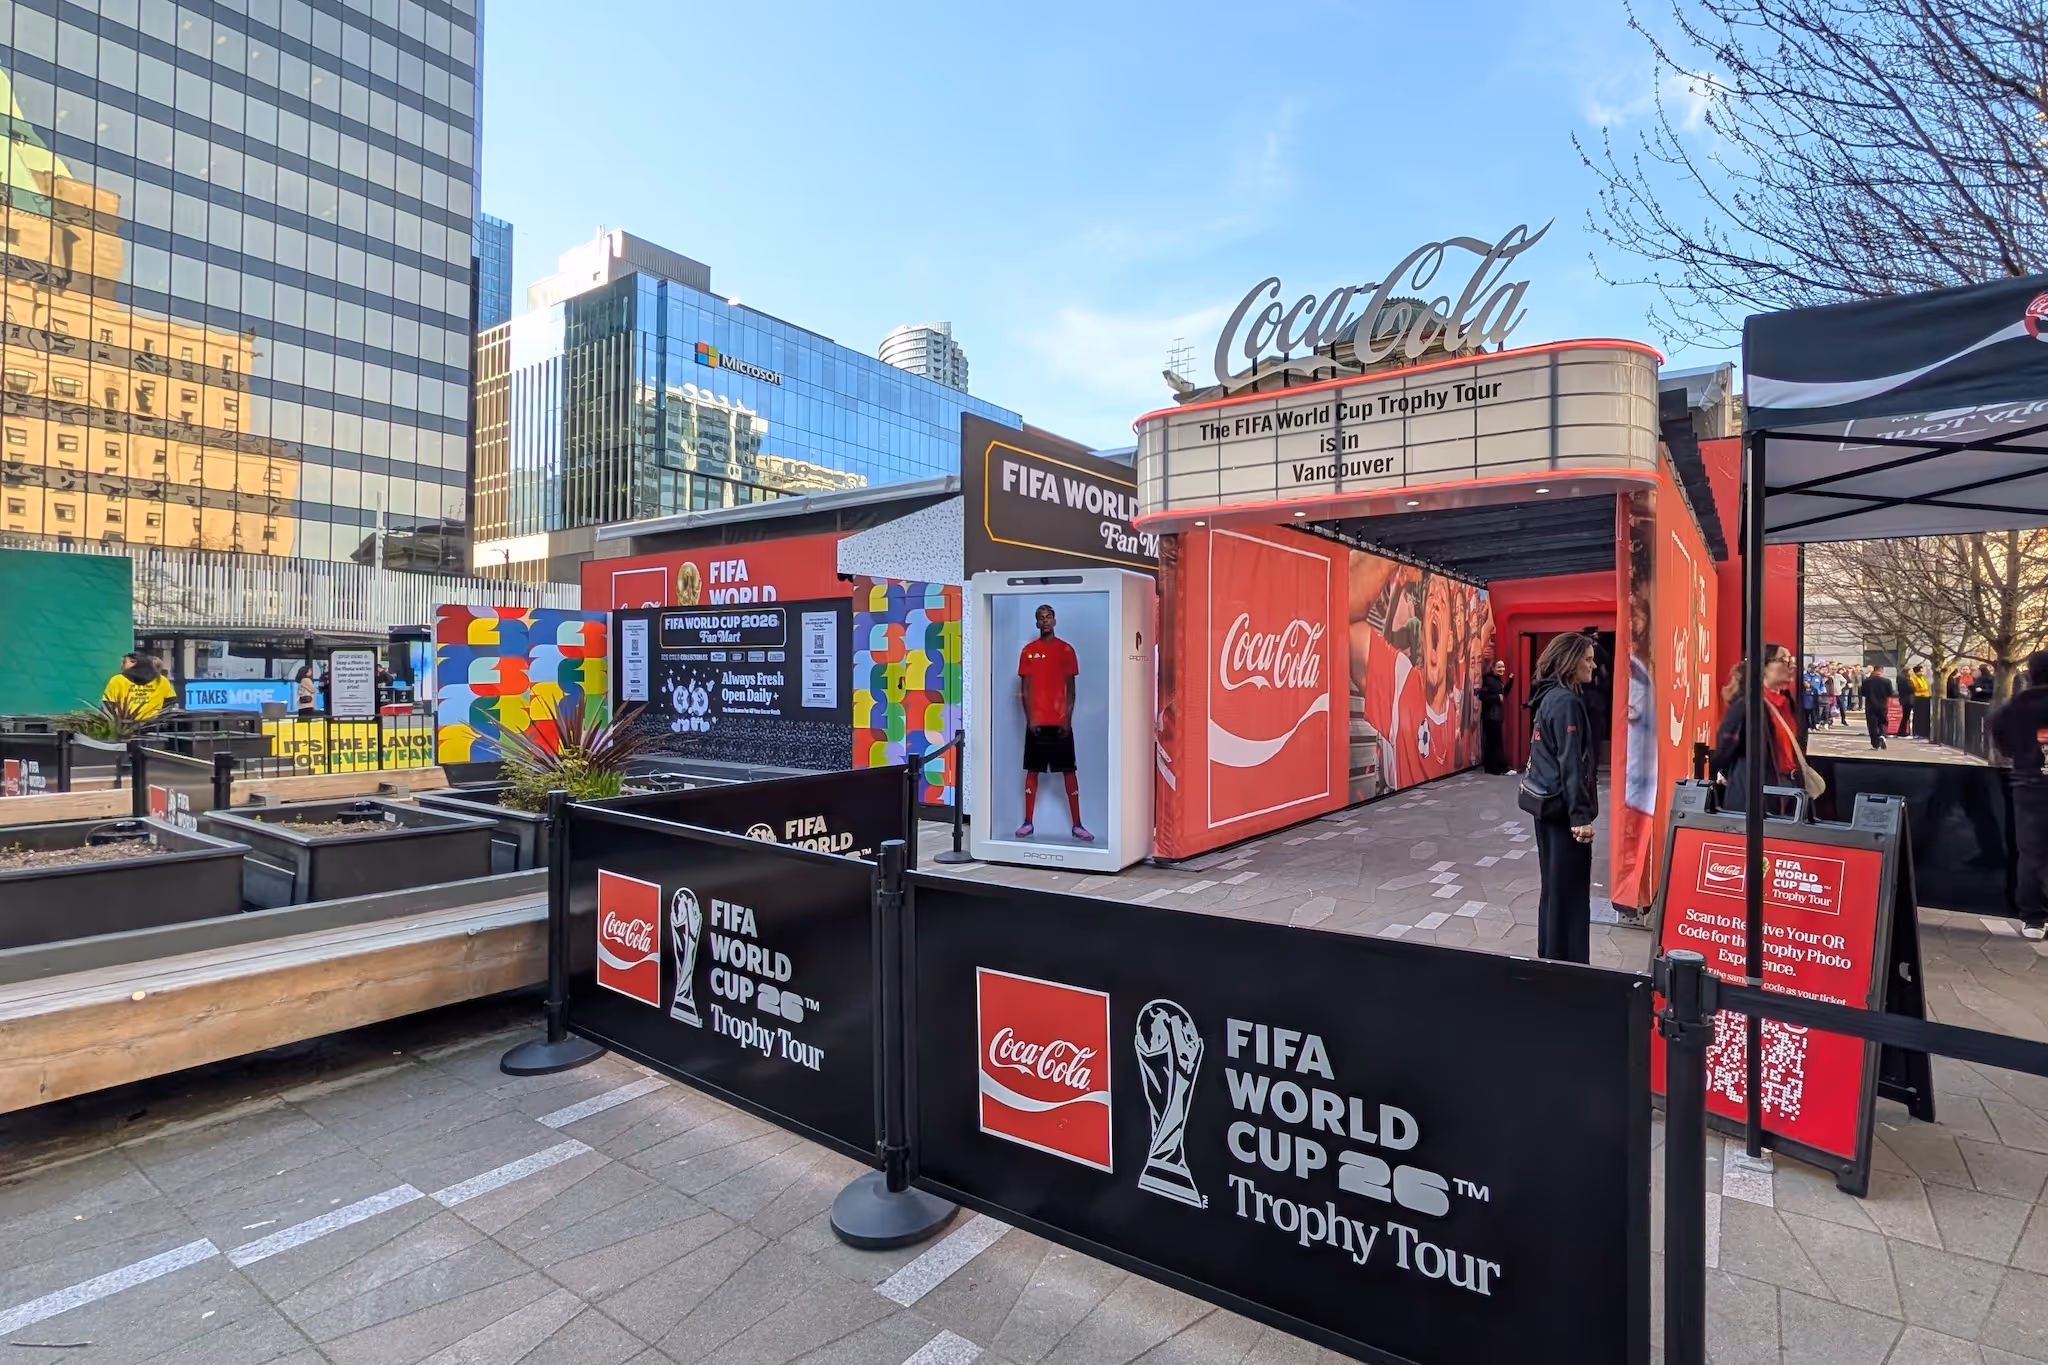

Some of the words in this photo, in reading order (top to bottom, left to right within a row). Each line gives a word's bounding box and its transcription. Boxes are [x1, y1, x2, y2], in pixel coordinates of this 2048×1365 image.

[1214, 217, 1555, 390] Coca-Cola
[721, 353, 782, 385] Microsoft
[1200, 424, 1230, 441] The
[1235, 414, 1272, 436] FIFA
[1276, 406, 1329, 430] World
[1336, 402, 1373, 422] Cup
[1377, 389, 1448, 415] Trophy
[1453, 382, 1503, 403] Tour
[1320, 433, 1336, 453] is
[1341, 432, 1359, 450] in
[1003, 460, 1061, 504] FIFA
[1293, 456, 1395, 482] Vancouver
[1100, 521, 1139, 554] Fan
[709, 559, 748, 584] FIFA
[664, 617, 684, 630] FIFA
[685, 616, 719, 630] WORLD
[720, 616, 740, 629] CUP
[741, 614, 778, 628] 2026
[699, 630, 717, 643] Fan
[717, 630, 741, 643] Mart
[1220, 612, 1326, 690] Coca-Cola
[721, 671, 756, 688] Always
[756, 671, 784, 686] Fresh
[196, 690, 227, 704] TAKES
[228, 689, 274, 704] MORE
[721, 688, 746, 704] Open
[746, 688, 773, 705] Daily
[330, 738, 363, 750] THE
[332, 750, 394, 765] EVERY
[785, 815, 827, 840] FIFA
[1023, 852, 1064, 861] PROTO
[1710, 862, 1742, 876] Coca-Cola
[1775, 859, 1801, 870] FIFA
[1773, 878, 1797, 889] CUP
[1774, 869, 1818, 882] WORLD
[1772, 889, 1807, 903] Trophy
[1808, 894, 1832, 906] Tour
[603, 911, 654, 953] Coca-Cola
[711, 899, 758, 938] FIFA
[1685, 908, 1717, 924] Scan
[1717, 914, 1730, 927] to
[1731, 916, 1784, 937] Reive
[1786, 927, 1820, 945] Your
[1822, 934, 1845, 950] QR
[710, 932, 792, 982] WORLD
[1678, 923, 1710, 939] Code
[1711, 929, 1730, 945] for
[1731, 934, 1747, 947] th
[1762, 941, 1806, 962] rophy
[1807, 949, 1852, 970] Photo
[710, 967, 754, 1004] CUP
[1763, 980, 1786, 993] code
[1786, 987, 1796, 996] as
[1797, 989, 1820, 1001] your
[710, 1003, 775, 1057] Trophy
[778, 1028, 824, 1071] Tour
[1226, 1018, 1335, 1080] FIFA
[989, 1027, 1098, 1091] Coca-Cola
[1225, 1067, 1419, 1150] WORLD
[1227, 1121, 1327, 1180] CUP
[1228, 1173, 1380, 1265] Trophy
[1387, 1221, 1501, 1296] Tour
